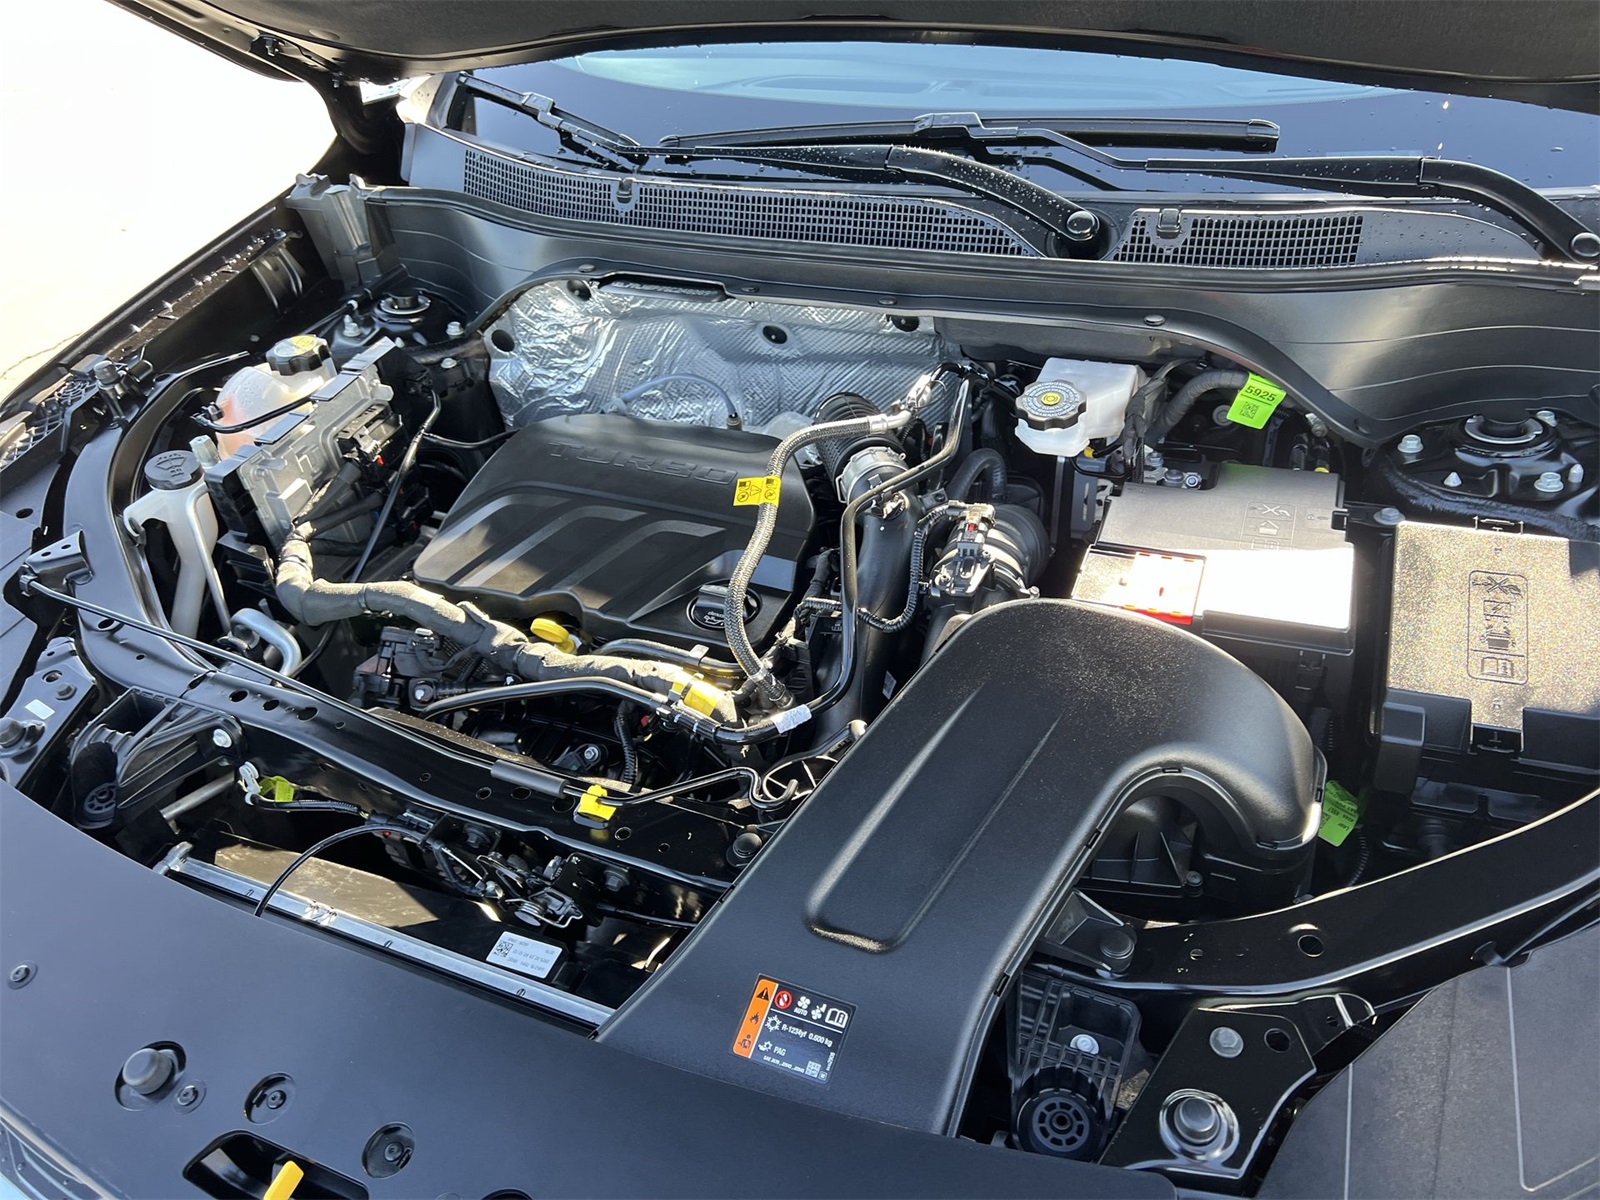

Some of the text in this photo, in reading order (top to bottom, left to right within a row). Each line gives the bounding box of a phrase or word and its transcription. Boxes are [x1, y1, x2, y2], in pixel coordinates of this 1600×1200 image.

[1245, 385, 1277, 402] 5925
[548, 442, 738, 485] TURBO
[794, 1007, 808, 1016] AUTO
[781, 1024, 833, 1048] R-1234yf 0.600 kg
[773, 1046, 786, 1056] PAG
